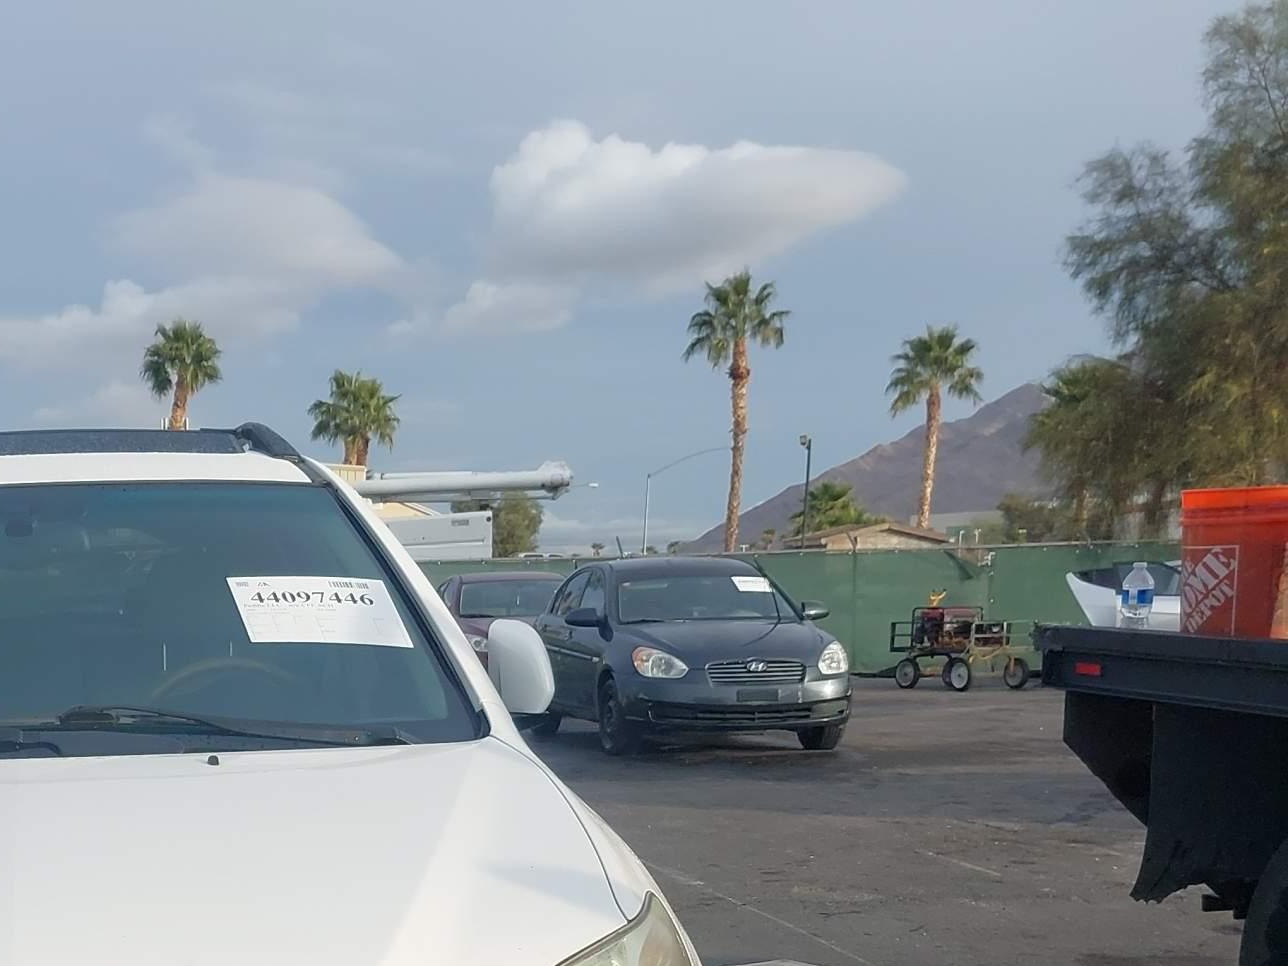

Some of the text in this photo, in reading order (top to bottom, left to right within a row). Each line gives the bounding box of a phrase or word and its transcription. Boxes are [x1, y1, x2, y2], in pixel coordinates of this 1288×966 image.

[250, 590, 374, 606] 44097446
[1182, 548, 1237, 614] OME
[1185, 578, 1235, 633] DEPOT
